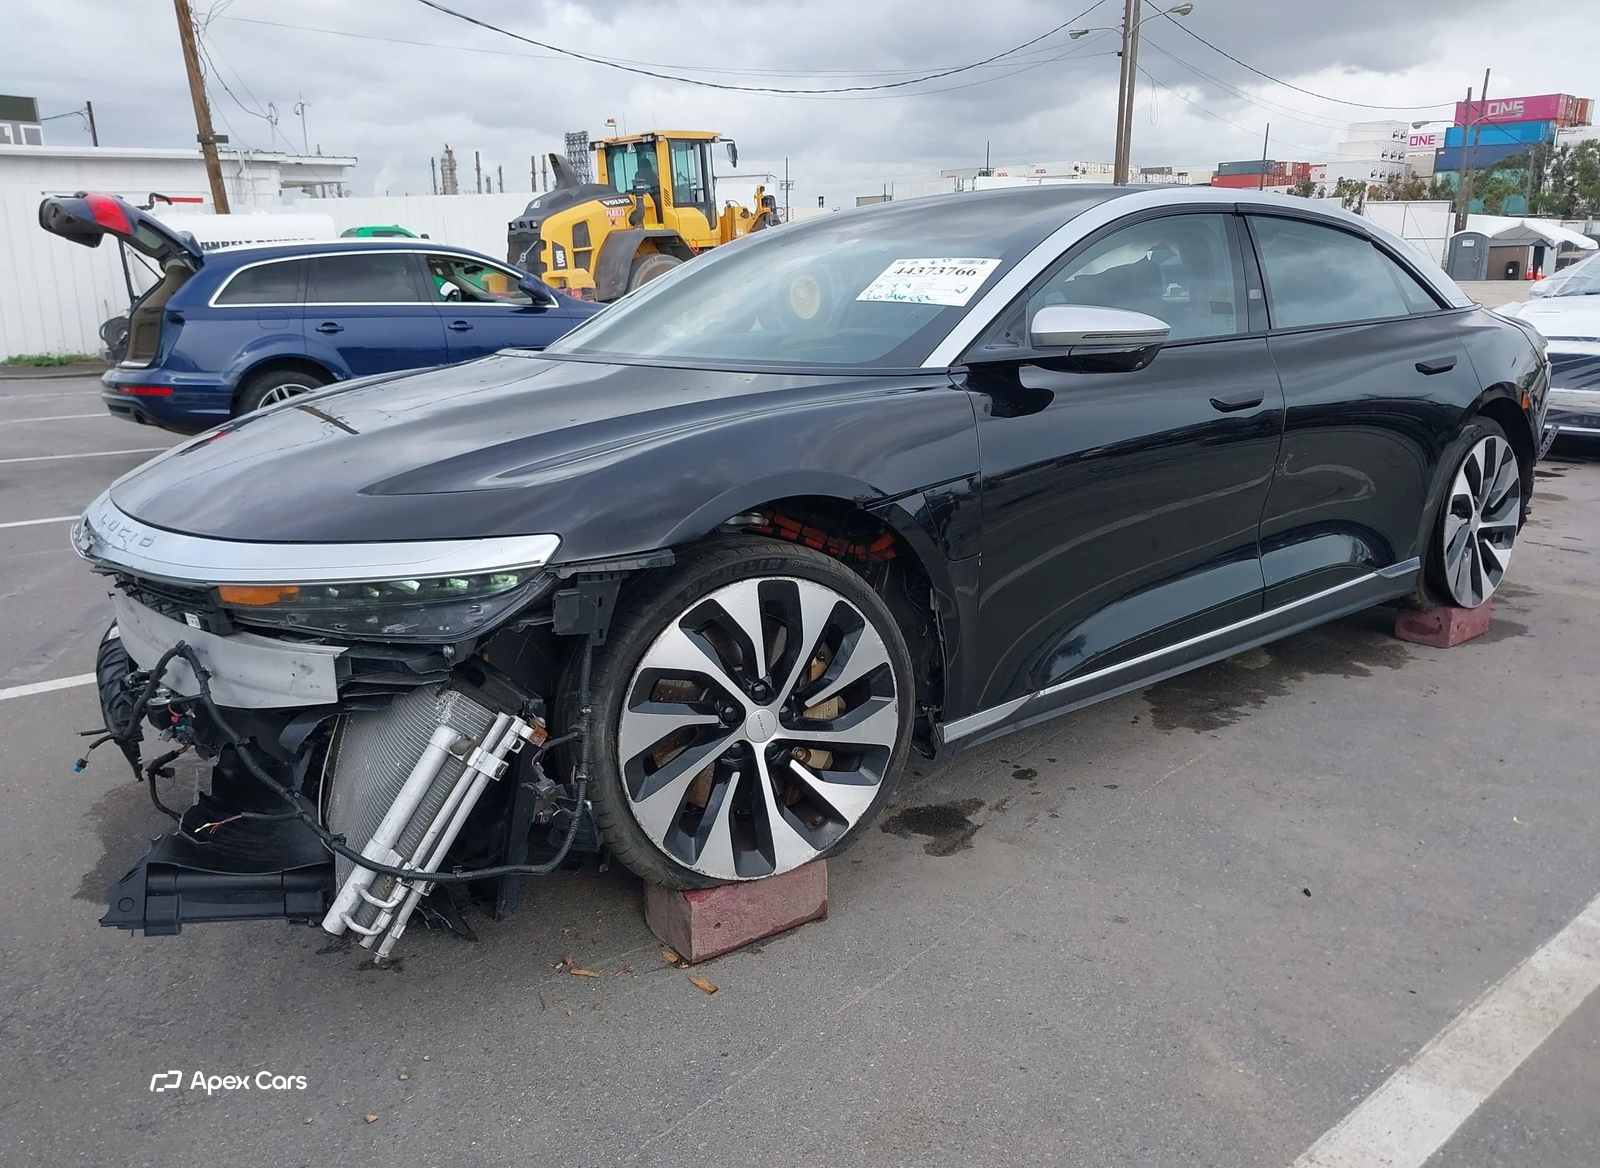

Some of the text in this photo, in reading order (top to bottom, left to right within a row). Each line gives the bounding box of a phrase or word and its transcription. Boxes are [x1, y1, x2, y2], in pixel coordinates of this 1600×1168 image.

[1487, 101, 1524, 115] ONE
[1409, 135, 1436, 146] ONE
[602, 198, 630, 206] VOLVO
[893, 266, 977, 277] 44373766
[101, 513, 155, 548] LUCID
